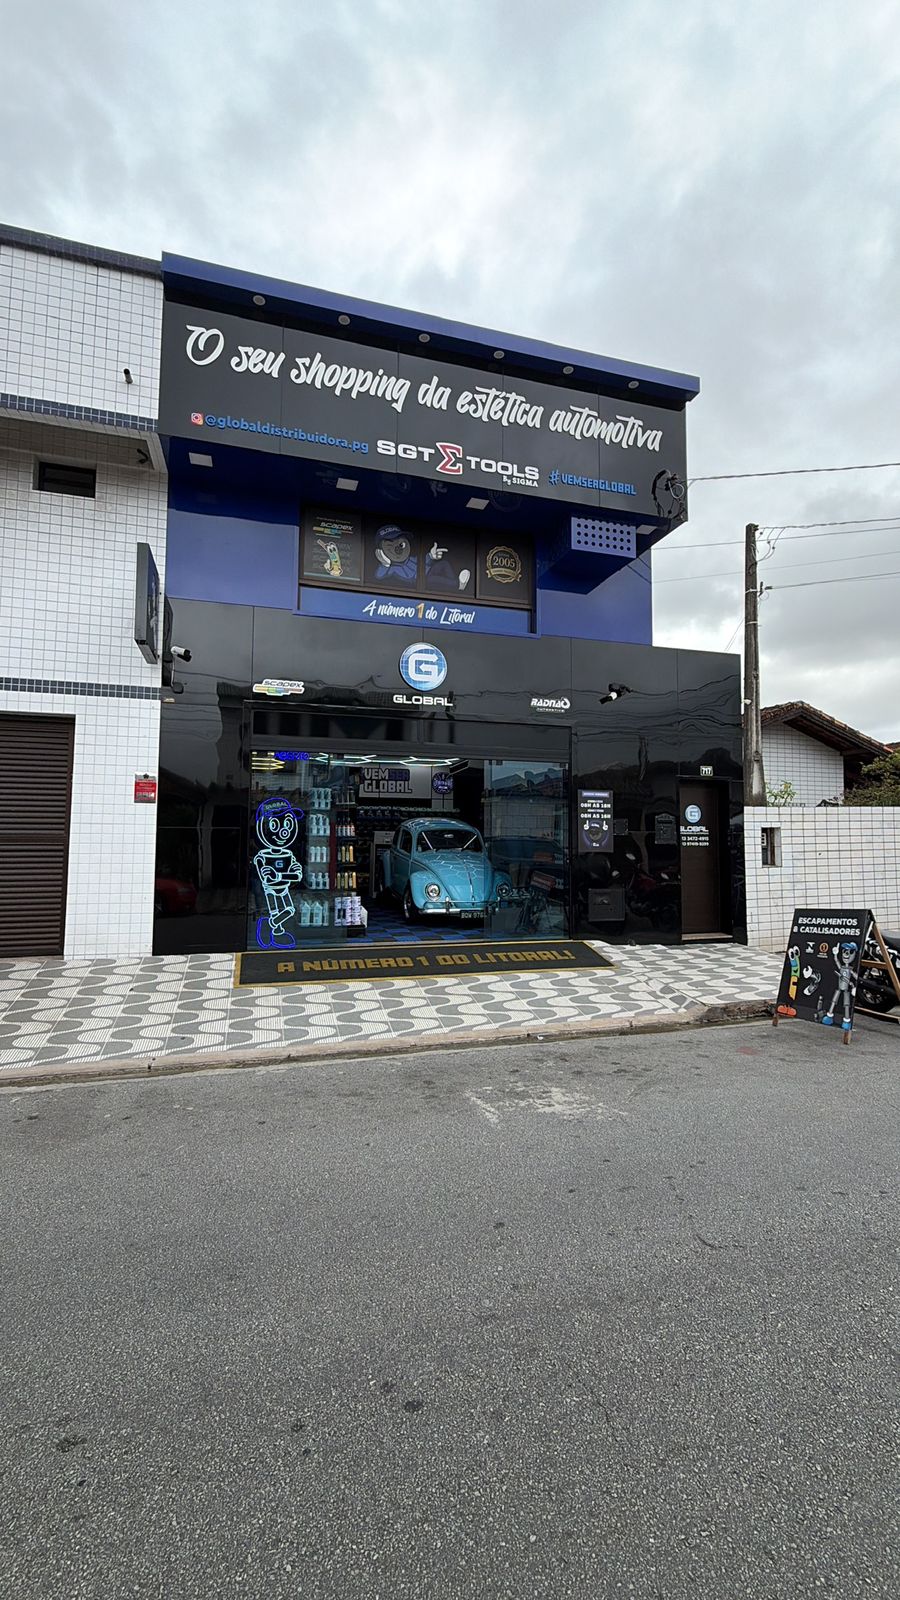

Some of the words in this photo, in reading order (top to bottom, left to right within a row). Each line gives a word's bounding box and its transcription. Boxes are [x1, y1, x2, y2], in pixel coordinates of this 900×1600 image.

[186, 325, 225, 366] O
[230, 345, 286, 378] seu
[290, 352, 411, 413] shopping
[417, 376, 452, 410] da
[456, 386, 544, 428] estética
[549, 405, 663, 452] automotiva
[205, 414, 369, 453] @globaldistribuidora.pg
[377, 440, 434, 462] SGT
[466, 456, 539, 480] TOOLS
[512, 477, 539, 487] SIGMA
[493, 556, 516, 568] 2005
[362, 600, 376, 616] A
[378, 602, 415, 618] número
[416, 602, 425, 619] 1
[425, 606, 438, 620] do
[440, 607, 475, 625] Litoral
[263, 680, 303, 688] scapex
[393, 694, 453, 706] GLOBAL
[364, 781, 412, 793] GLOBAL
[798, 917, 858, 926] ESCAPAMENTOS
[800, 926, 861, 936] CATALISADORES
[277, 961, 296, 973] A
[416, 956, 430, 966] 1
[436, 954, 471, 966] DO
[473, 950, 577, 964] LITORAL!
